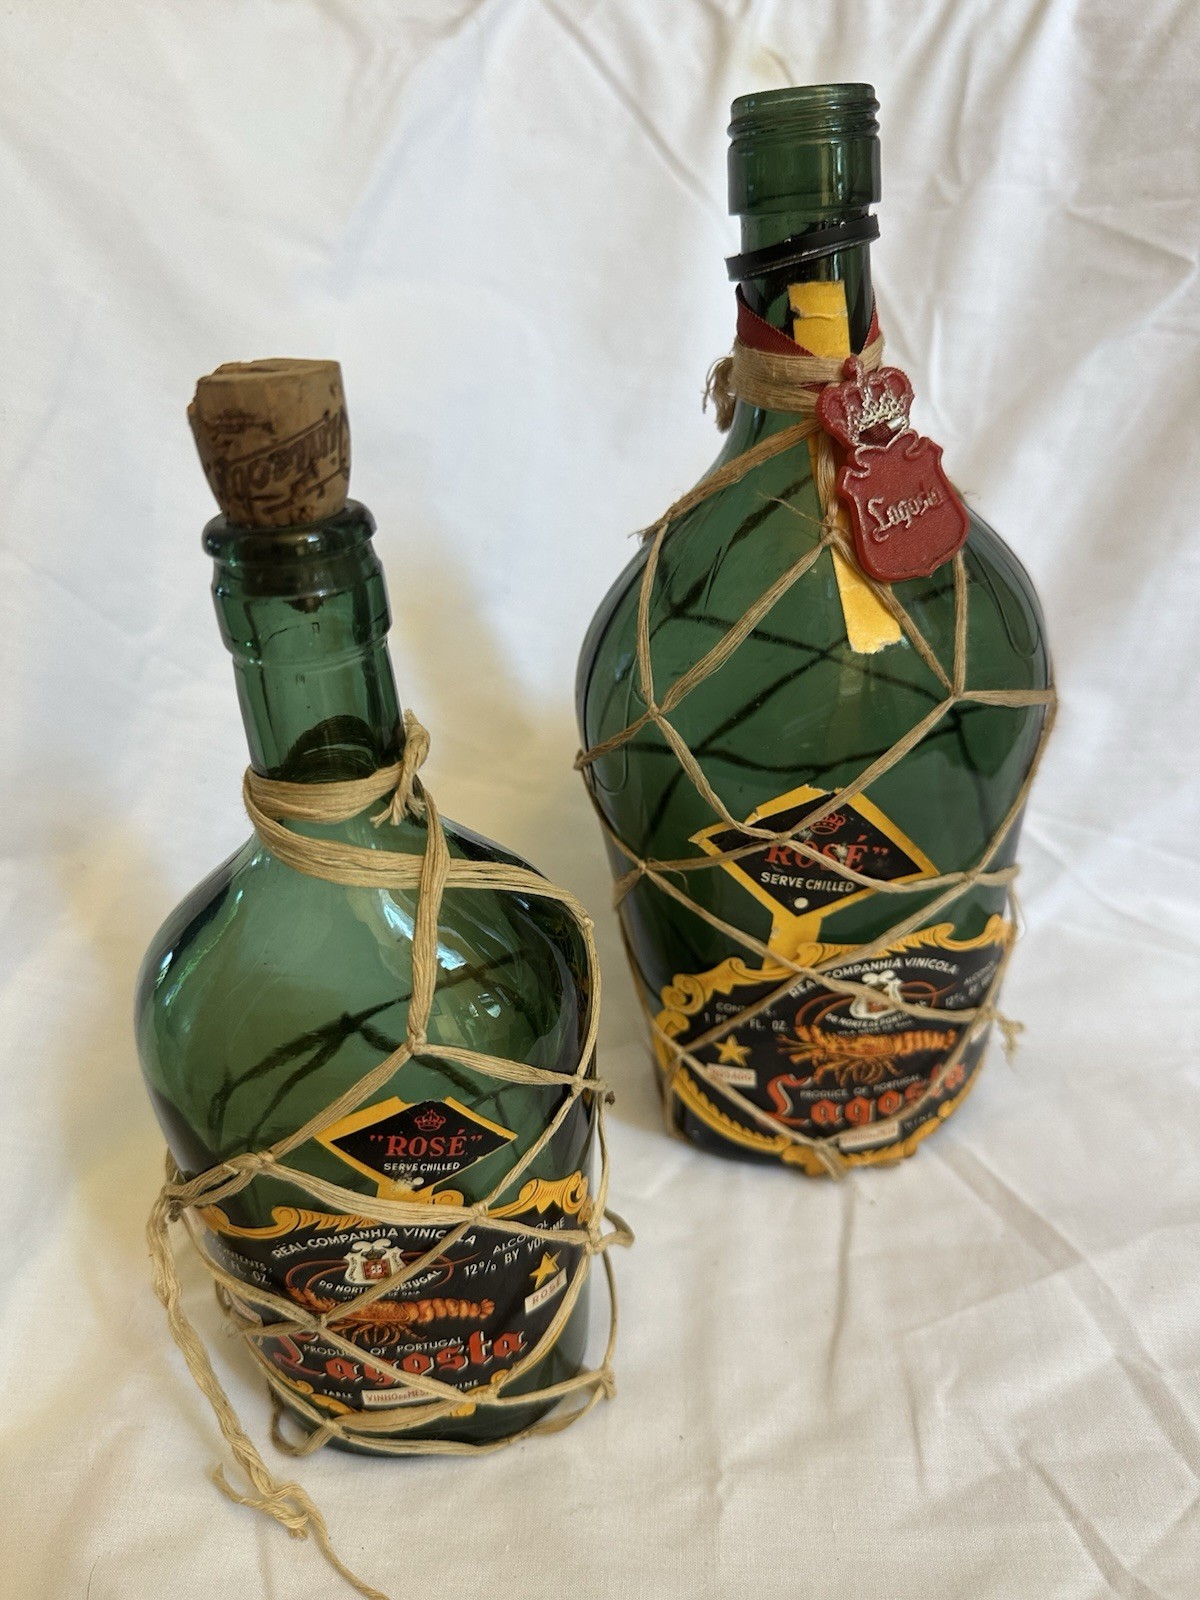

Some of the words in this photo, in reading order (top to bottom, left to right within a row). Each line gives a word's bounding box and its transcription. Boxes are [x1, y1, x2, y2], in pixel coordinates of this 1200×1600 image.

[760, 871, 803, 889] SERVE
[805, 878, 855, 892] CHILLED
[788, 977, 818, 998] REA
[824, 959, 902, 980] COMPANHIA
[904, 956, 960, 975] VINICOLA
[383, 1161, 419, 1172] SERVE
[419, 1161, 461, 1173] CHILLED
[271, 1240, 308, 1259] REAL
[307, 1226, 399, 1248] COMPANHIA
[504, 1247, 520, 1265] BY
[319, 1279, 334, 1290] DO
[335, 1285, 368, 1295] NORT
[393, 1269, 443, 1292] ORTUGAL
[303, 1344, 353, 1357] PRODU
[369, 1345, 387, 1356] OF
[396, 1335, 464, 1353] PORTUGAL
[366, 1392, 398, 1403] VINHO
